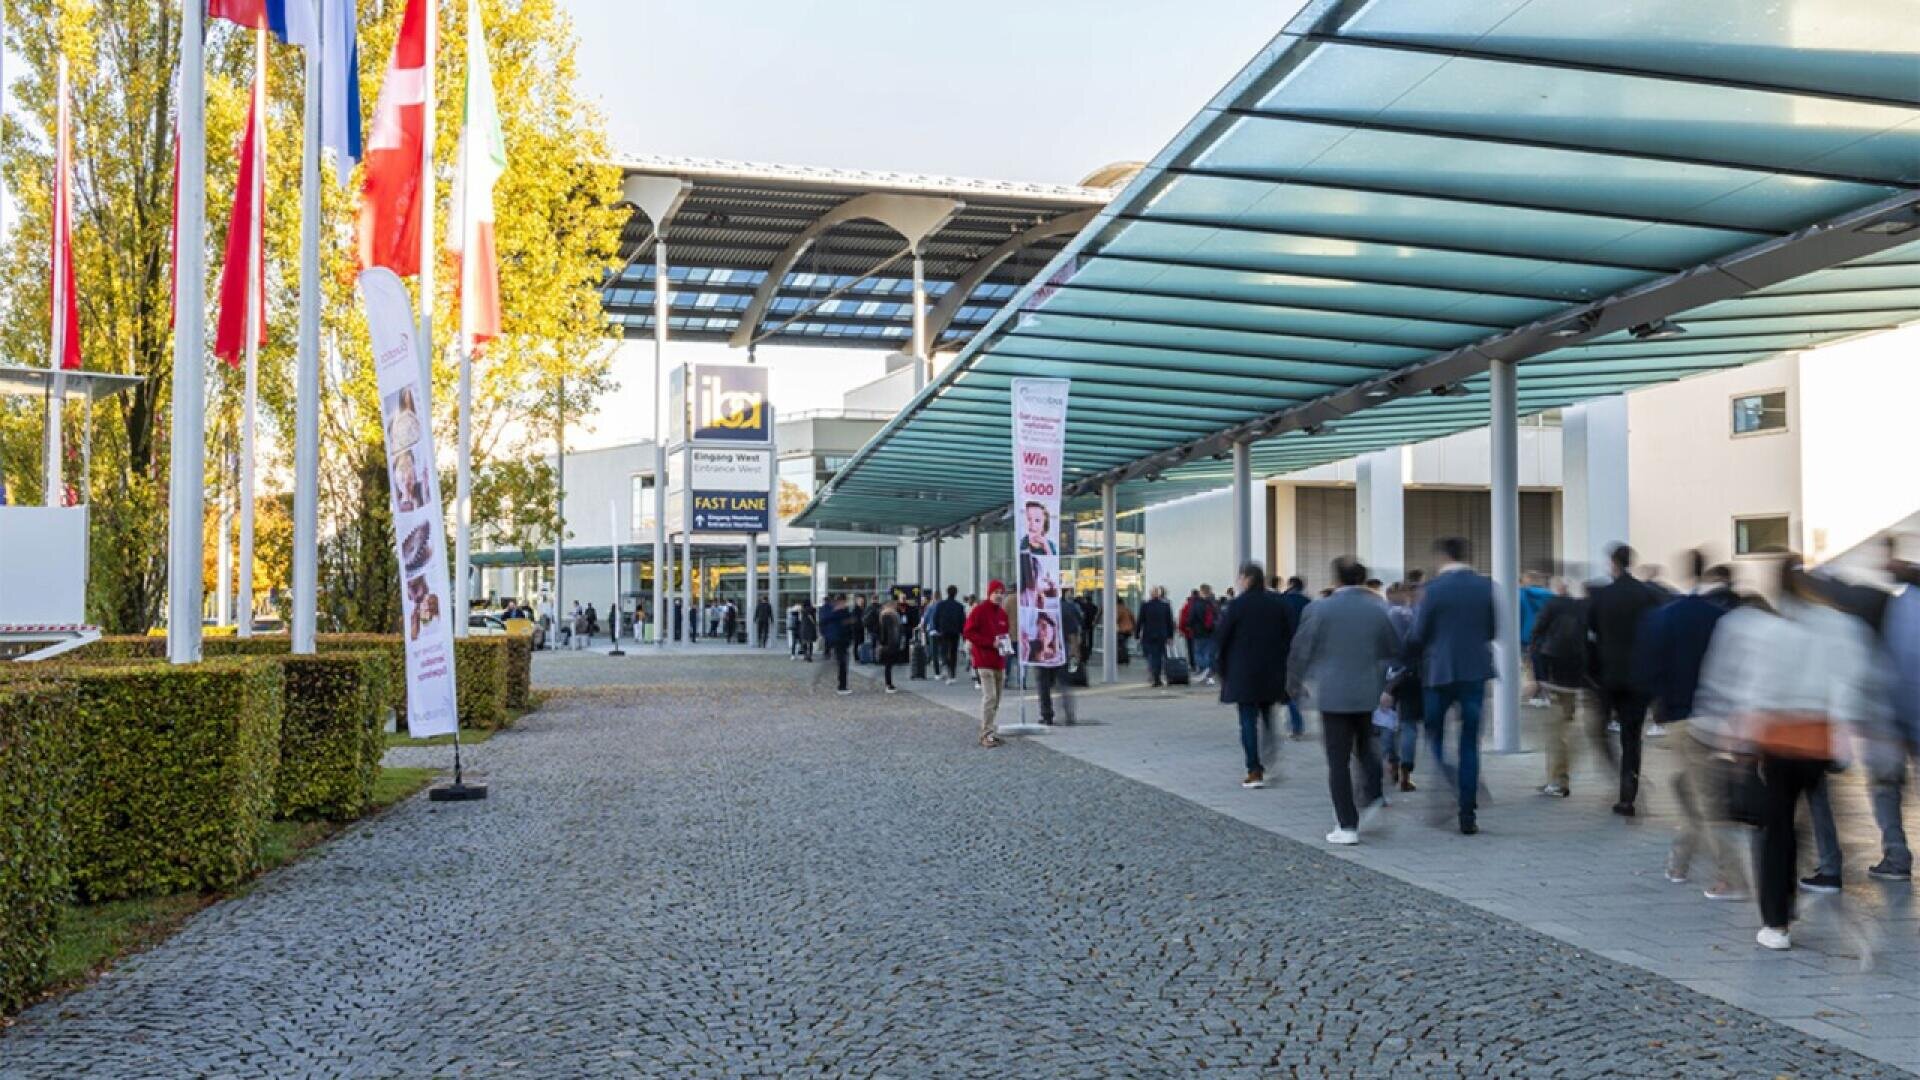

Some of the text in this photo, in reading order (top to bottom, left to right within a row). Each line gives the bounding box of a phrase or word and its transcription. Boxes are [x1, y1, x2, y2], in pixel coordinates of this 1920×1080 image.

[694, 452, 760, 463] Eingang West
[1023, 452, 1048, 466] Win
[694, 464, 762, 474] Entrance West
[695, 497, 766, 511] FAST LANE
